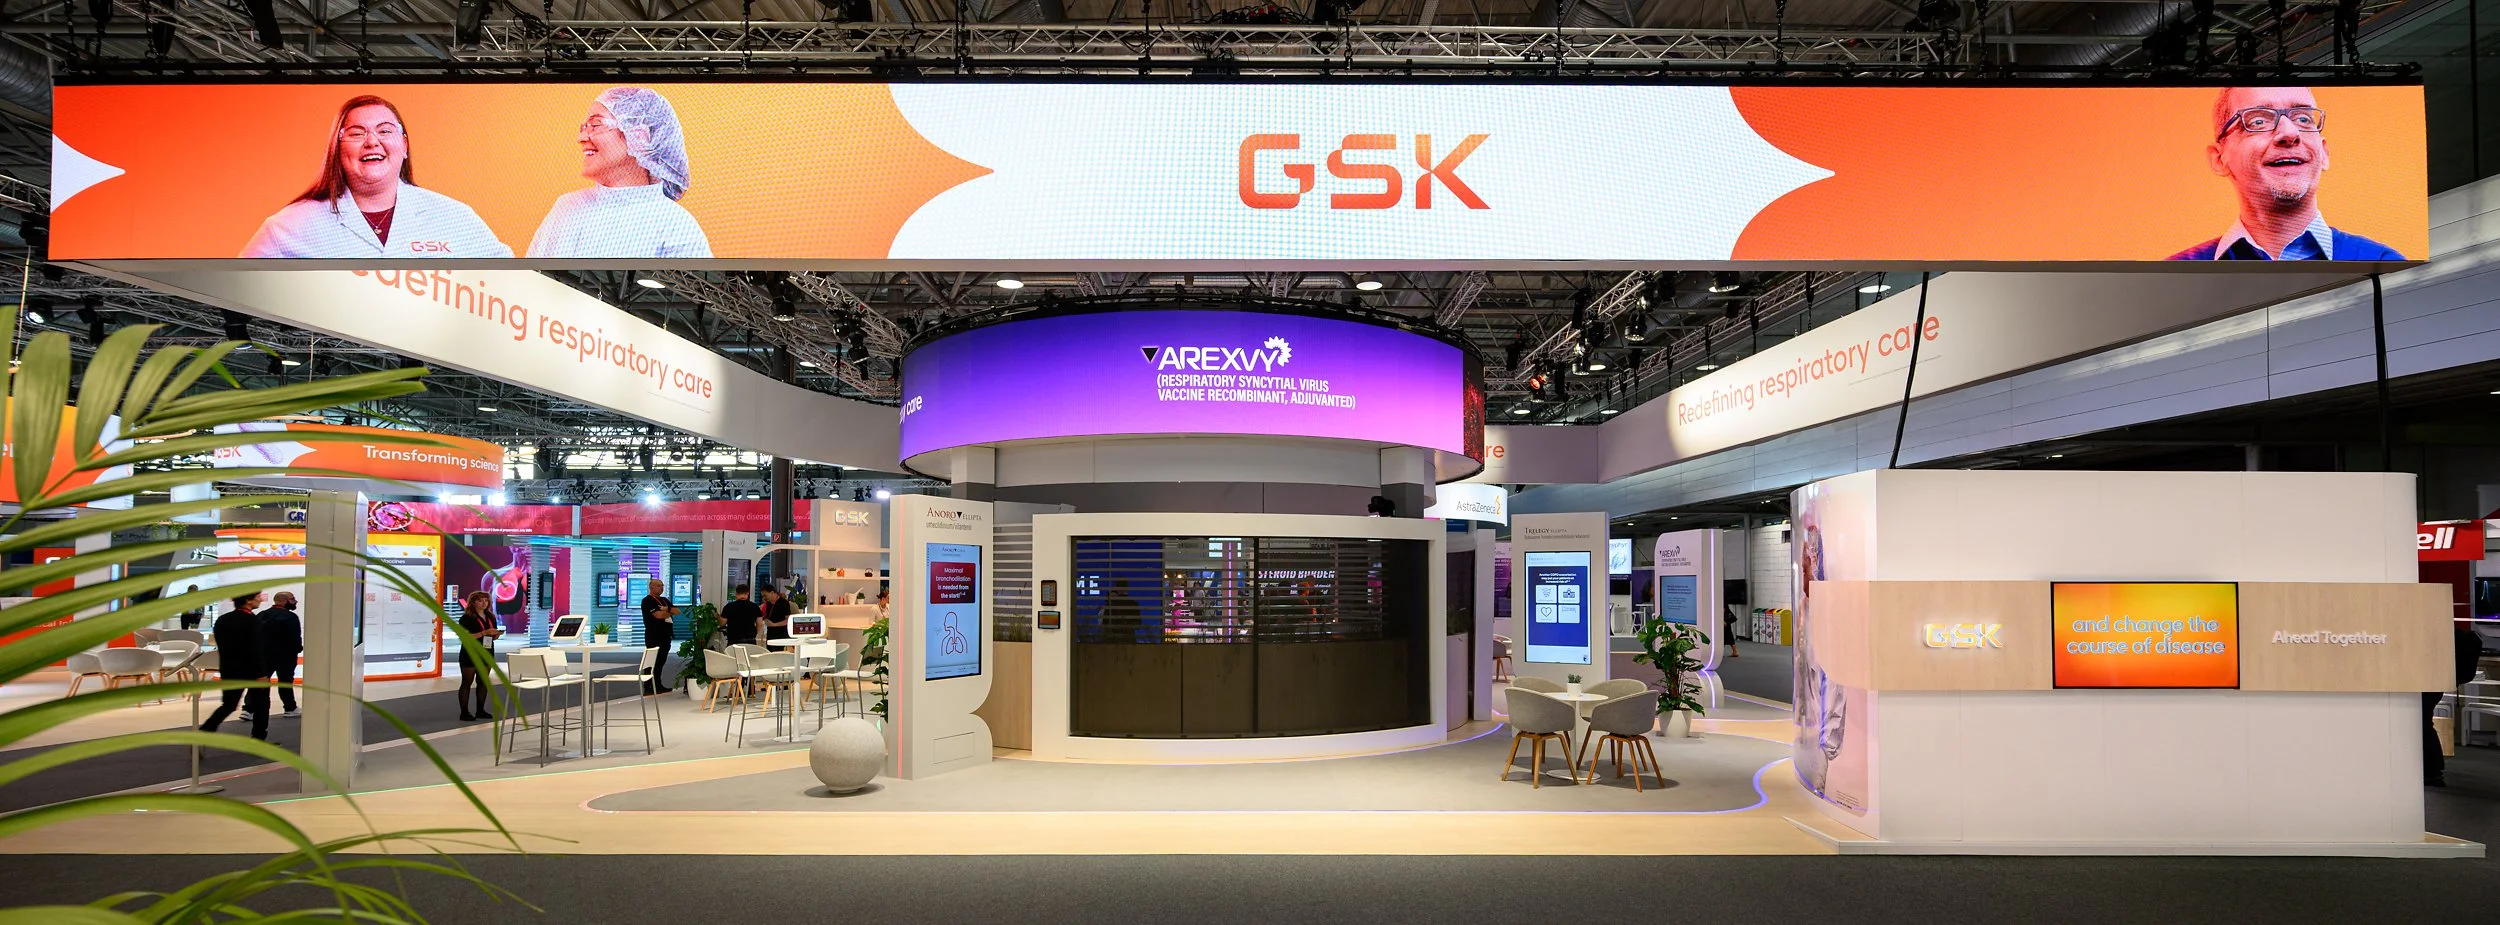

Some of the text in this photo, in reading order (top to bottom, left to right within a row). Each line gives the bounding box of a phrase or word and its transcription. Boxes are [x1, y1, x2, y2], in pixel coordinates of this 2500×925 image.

[1239, 134, 1491, 209] GSK
[410, 241, 451, 252] GSK
[351, 270, 713, 399] efining respiratory care
[1158, 345, 1281, 372] AREXVY
[1157, 373, 1329, 392] (RESPIRATORY SYNCYTIAL VIRUS
[1678, 384, 1755, 427] Redefining
[1759, 340, 1870, 398] respiratory
[1158, 388, 1356, 409] VACCINE RECOMBINANT, ADJUVANTED)
[362, 444, 499, 472] Transforming science
[727, 514, 746, 522] many
[835, 509, 869, 526] GSK
[1456, 501, 1496, 514] AstraZeneca
[2417, 527, 2455, 550] ell
[1924, 623, 2004, 648] GSK
[2072, 616, 2219, 638] and change the
[2066, 637, 2226, 654] course of disease
[2272, 630, 2387, 647] Ahead Together
